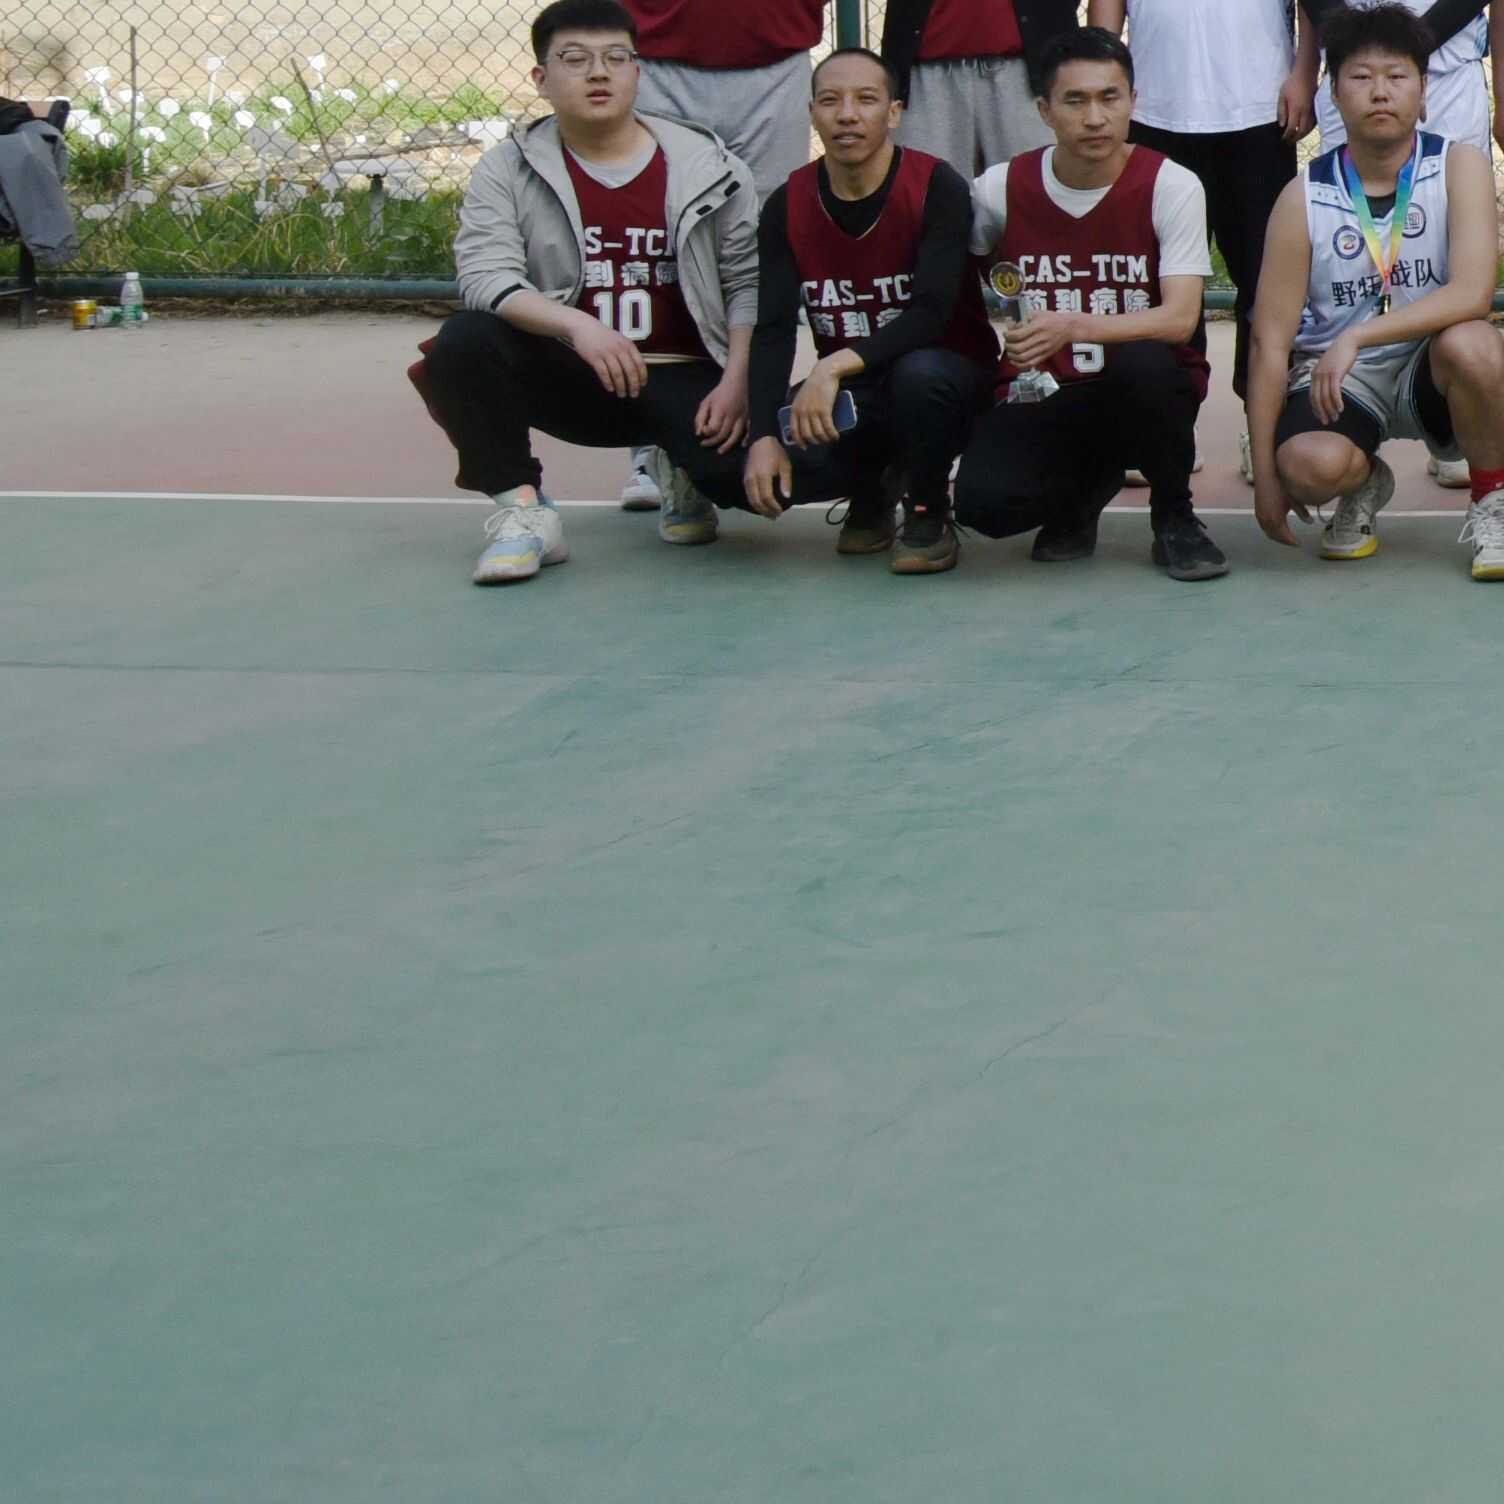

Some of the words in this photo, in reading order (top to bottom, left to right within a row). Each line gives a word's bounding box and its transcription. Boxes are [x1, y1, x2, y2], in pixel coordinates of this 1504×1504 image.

[585, 226, 673, 256] S-TC
[1019, 254, 1150, 284] CAS-TCM
[1332, 258, 1441, 308] 野牦战队
[802, 274, 914, 307] CAS-TC
[593, 288, 652, 341] 10
